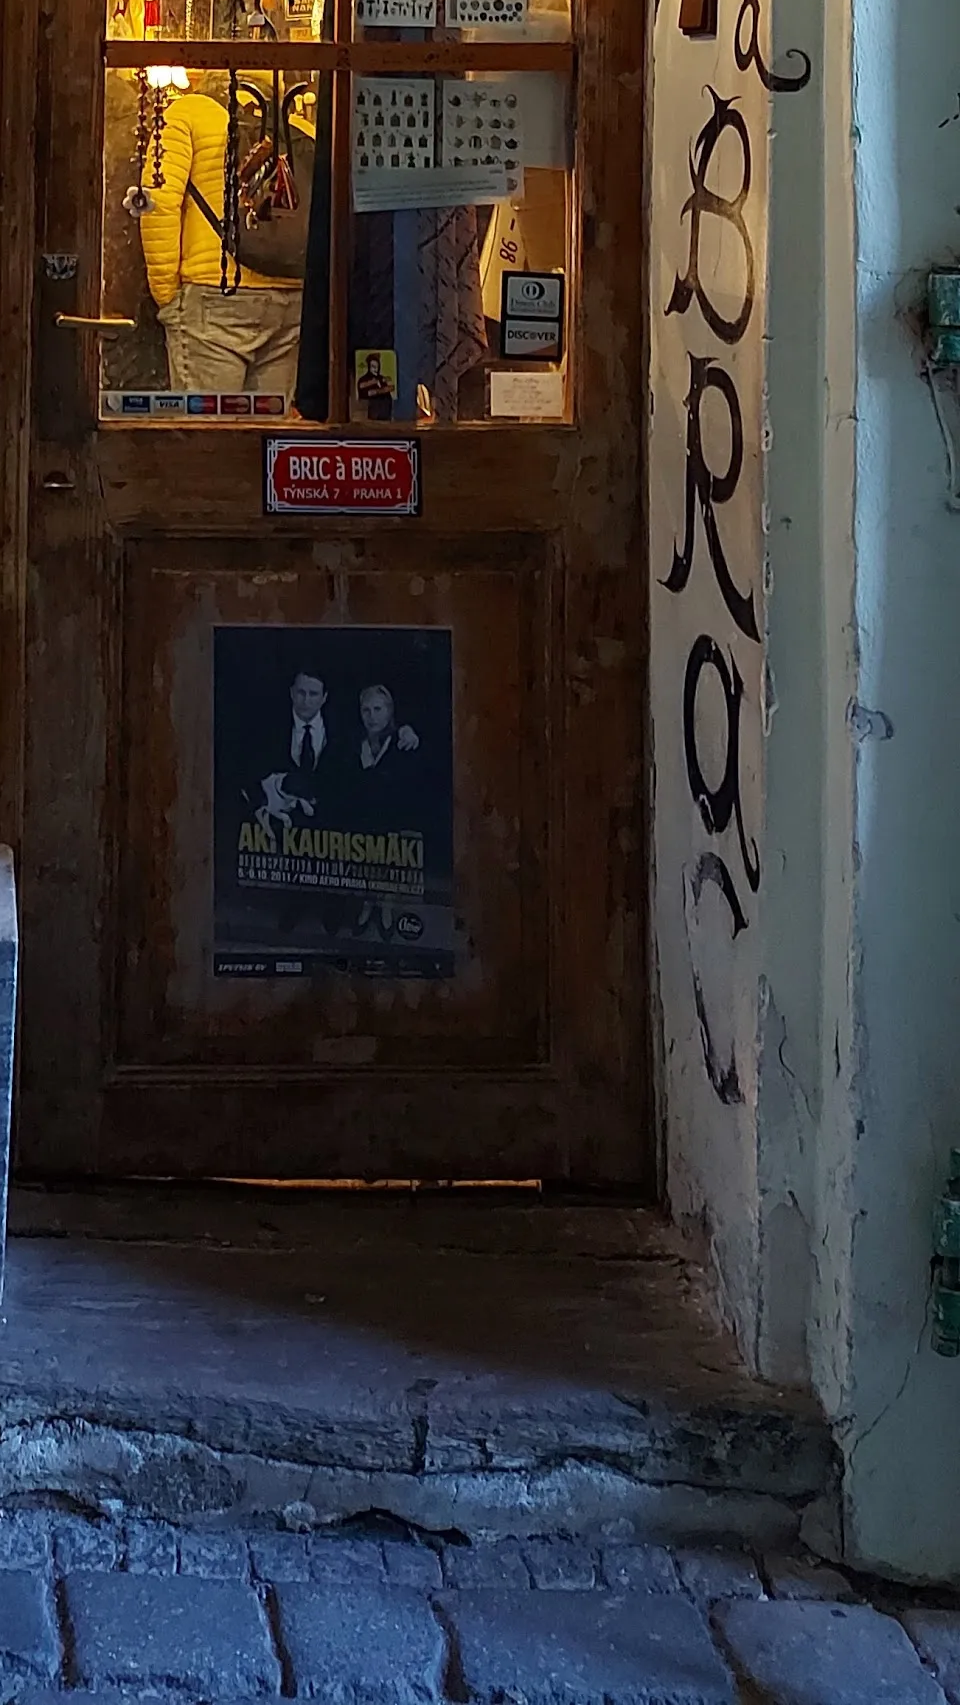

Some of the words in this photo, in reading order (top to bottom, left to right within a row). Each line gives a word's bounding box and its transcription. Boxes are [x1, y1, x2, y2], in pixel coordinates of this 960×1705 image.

[507, 330, 556, 342] DISCOVER
[159, 401, 180, 409] VISA
[289, 456, 331, 481] BRIC
[336, 455, 345, 481] à
[351, 457, 396, 481] BRAC
[282, 484, 329, 500] TÝNSKÁ
[334, 488, 340, 500] 7
[353, 488, 393, 500] PRAHA
[396, 488, 402, 499] 1
